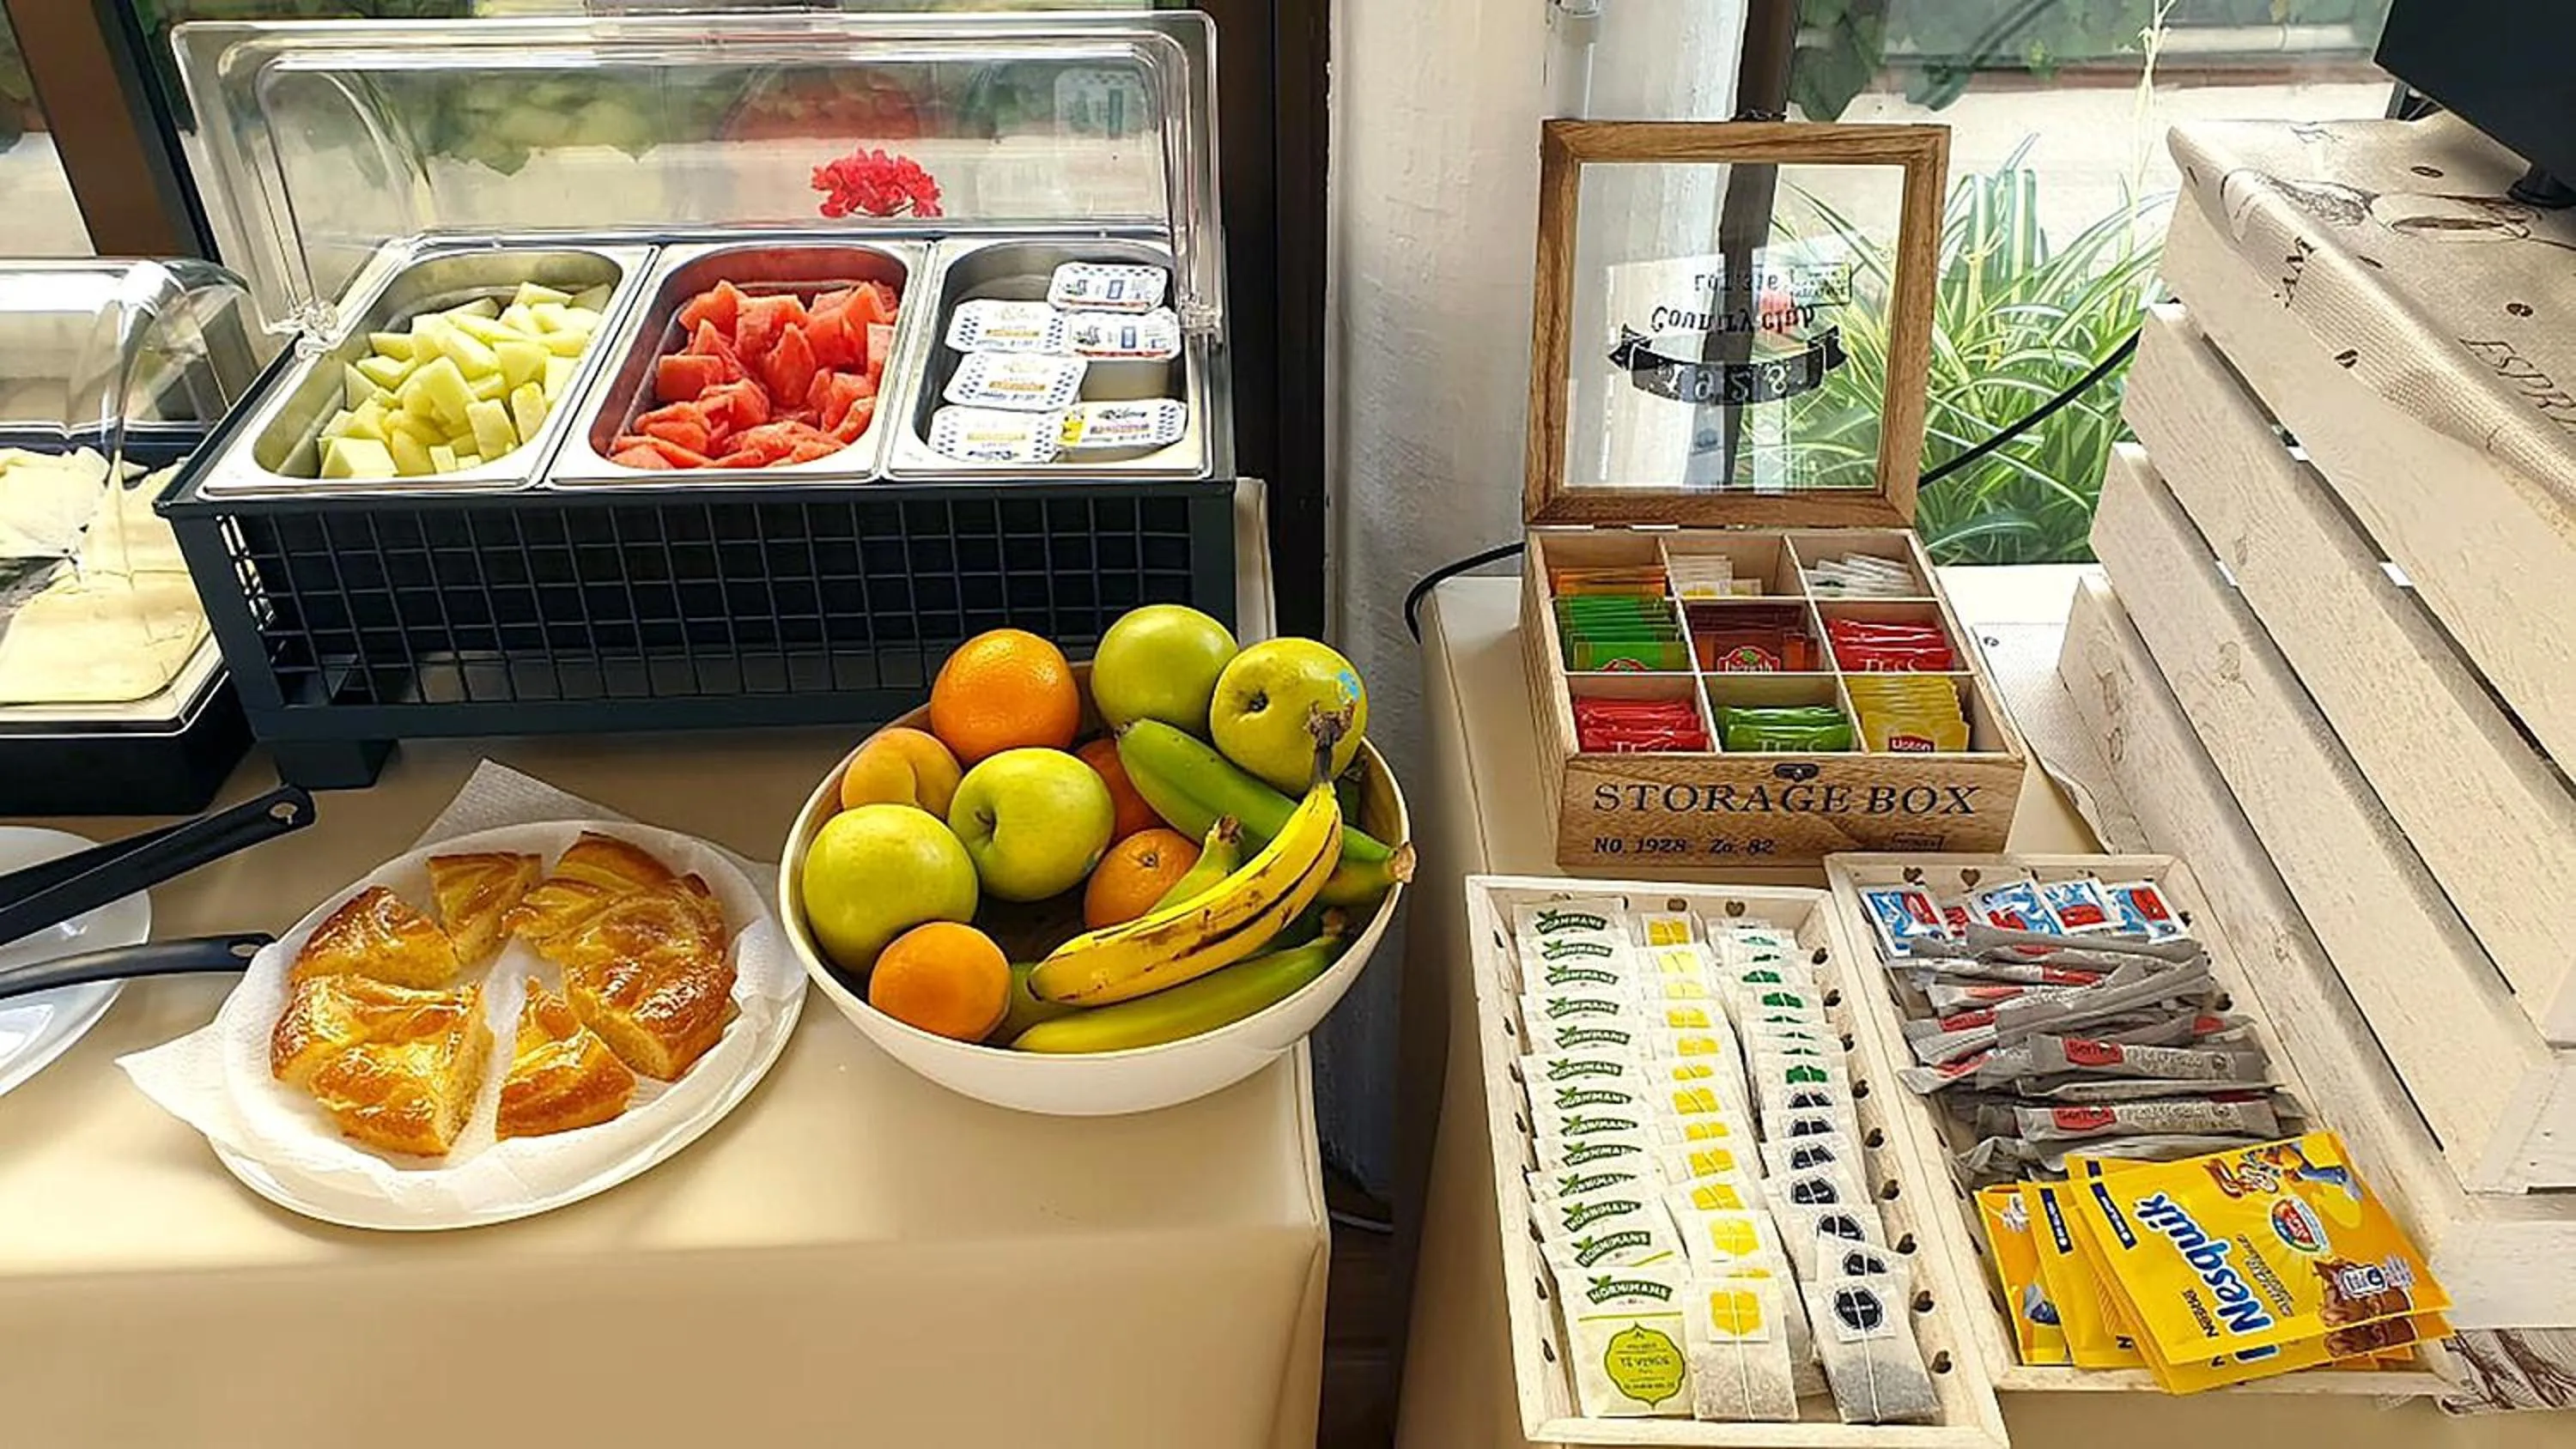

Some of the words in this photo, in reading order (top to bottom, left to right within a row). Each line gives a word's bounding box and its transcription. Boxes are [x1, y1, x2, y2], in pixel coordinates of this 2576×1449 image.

[1593, 782, 1853, 816] STORAGE
[1865, 785, 1984, 816] BOX
[1634, 837, 1687, 854] 1928
[2136, 1191, 2275, 1337] Nesquik
